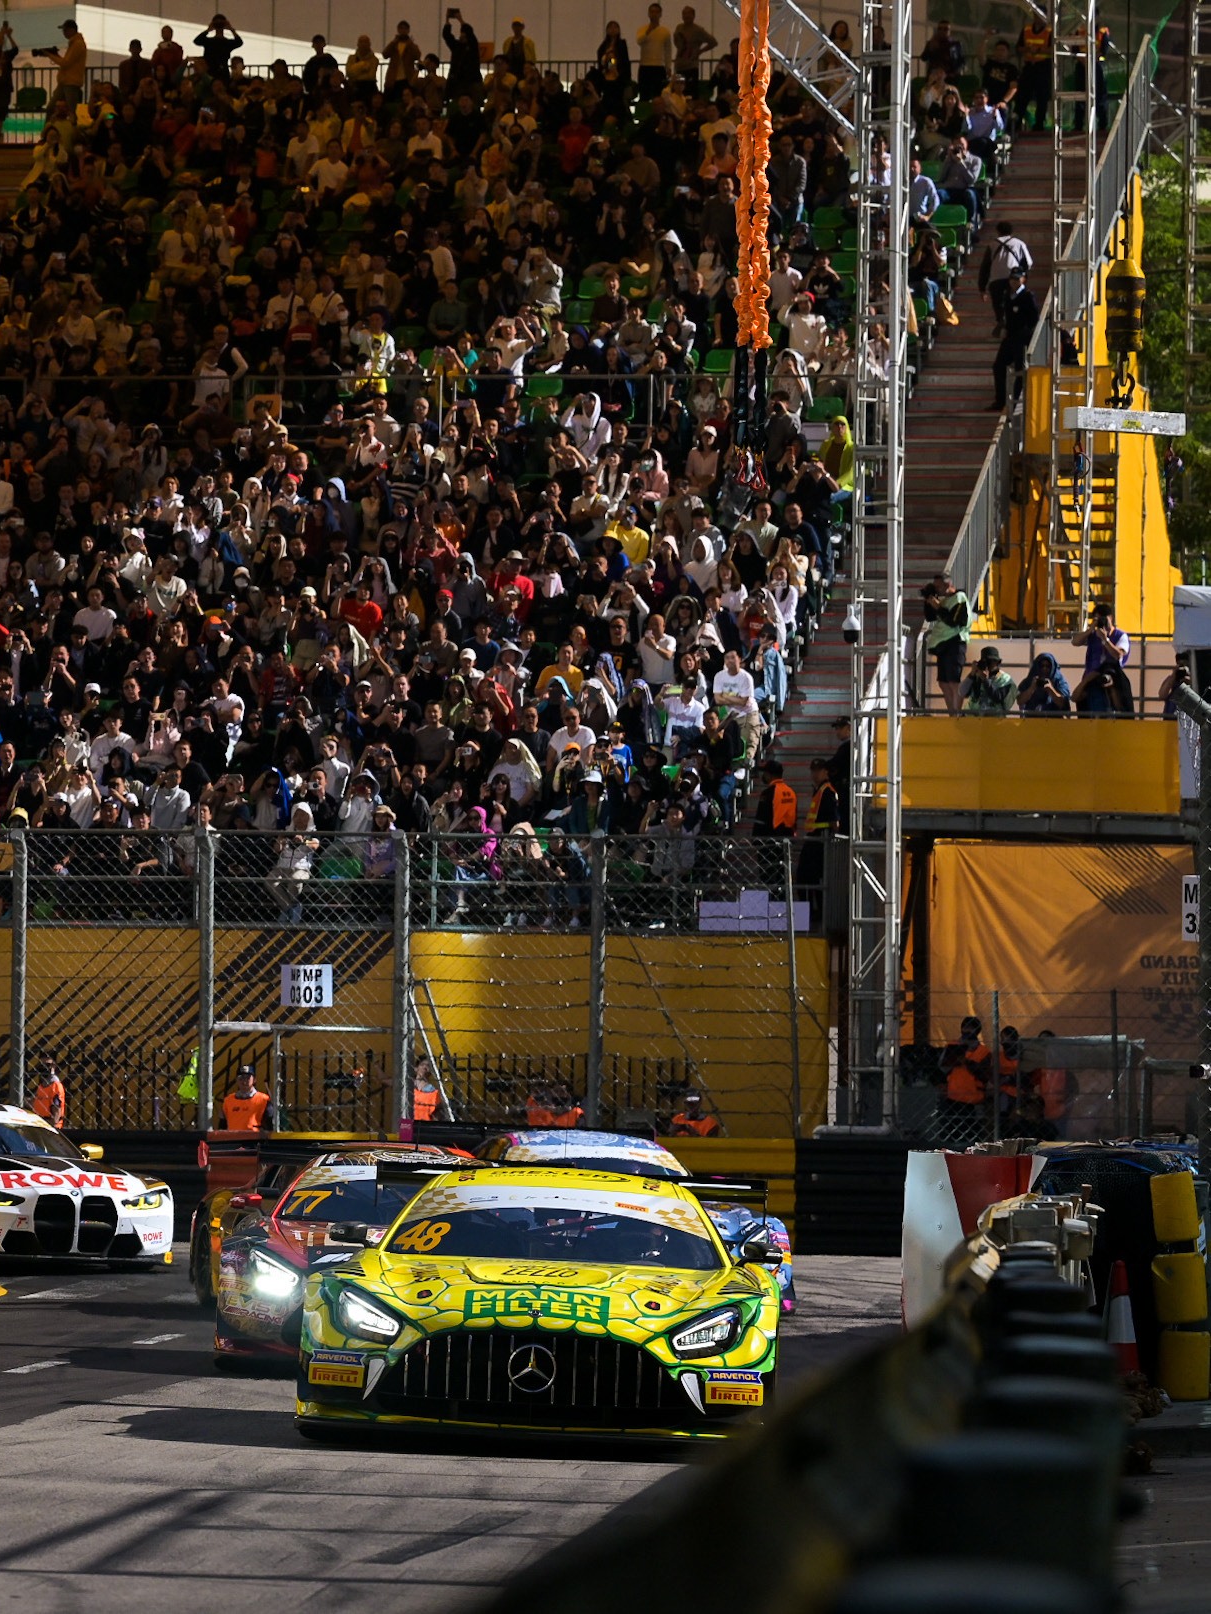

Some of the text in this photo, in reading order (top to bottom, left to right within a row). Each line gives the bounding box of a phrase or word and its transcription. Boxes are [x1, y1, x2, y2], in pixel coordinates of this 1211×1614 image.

[284, 1190, 333, 1214] 77
[142, 1231, 163, 1242] ROWE
[393, 1220, 451, 1251] 48
[473, 1290, 602, 1307] MANN
[471, 1300, 601, 1321] FILTER
[316, 1353, 359, 1363] RAVENOL
[312, 1367, 359, 1383] PIRELLI
[712, 1372, 757, 1381] RAVENOL
[711, 1386, 759, 1402] PIRELLI
